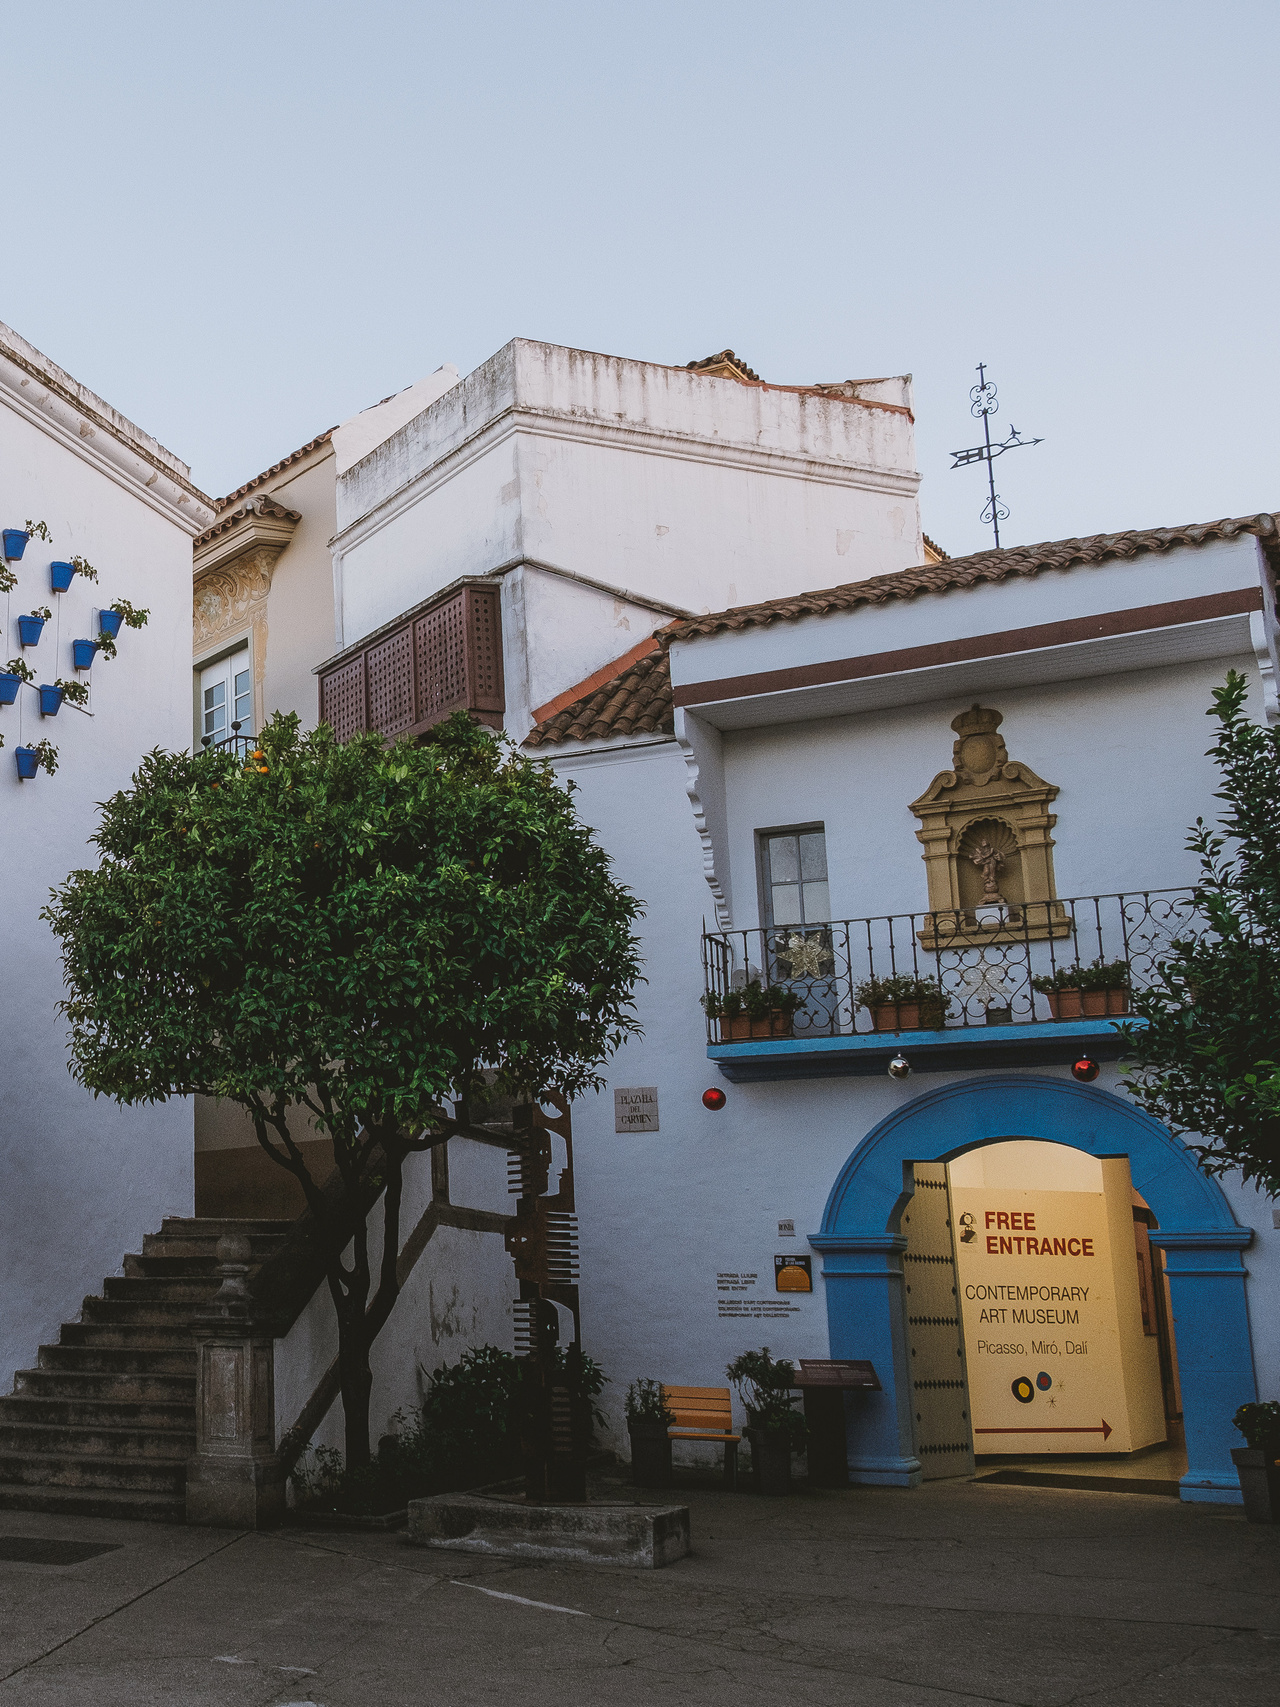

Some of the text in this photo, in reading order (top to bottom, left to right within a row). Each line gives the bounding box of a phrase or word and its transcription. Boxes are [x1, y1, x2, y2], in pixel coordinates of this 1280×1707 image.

[621, 1114, 652, 1124] CARMEN
[984, 1211, 1036, 1231] FREE
[986, 1235, 1095, 1257] ENTRANCE
[965, 1285, 1090, 1302] CONTEMPORARY
[980, 1308, 1080, 1324] ART MUSEUM
[977, 1340, 1088, 1356] Picasso, Miró, Dalí
